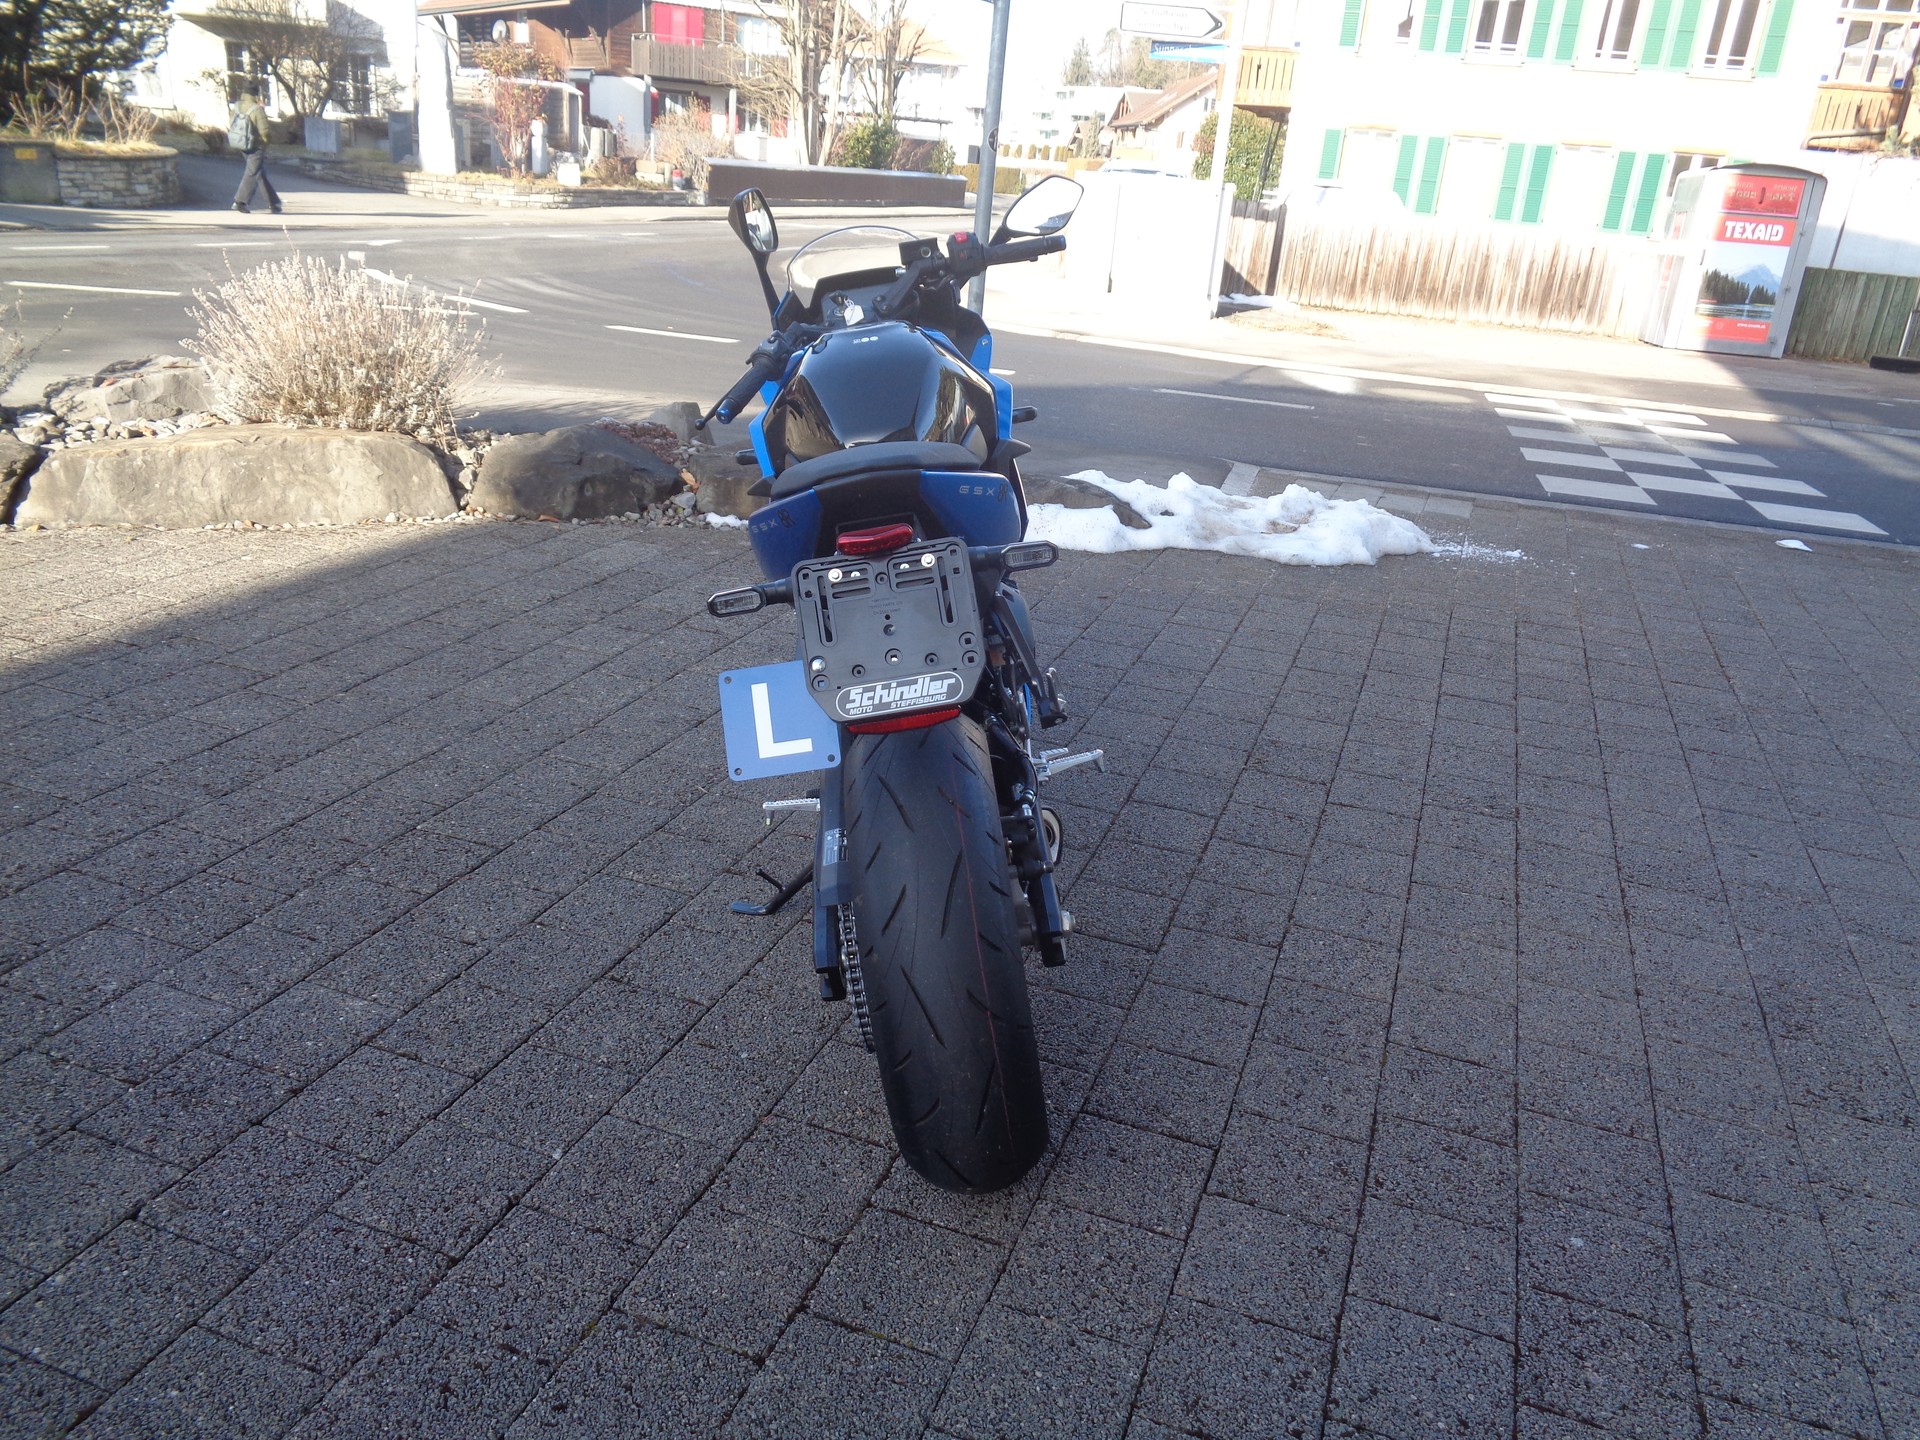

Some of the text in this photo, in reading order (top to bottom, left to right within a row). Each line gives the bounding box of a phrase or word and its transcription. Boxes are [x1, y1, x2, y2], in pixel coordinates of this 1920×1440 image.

[1725, 220, 1784, 242] TEXAID
[959, 485, 995, 497] GSX
[845, 676, 956, 709] Schindler
[849, 693, 947, 716] MOTO STEFFISBURG
[751, 682, 813, 759] L
